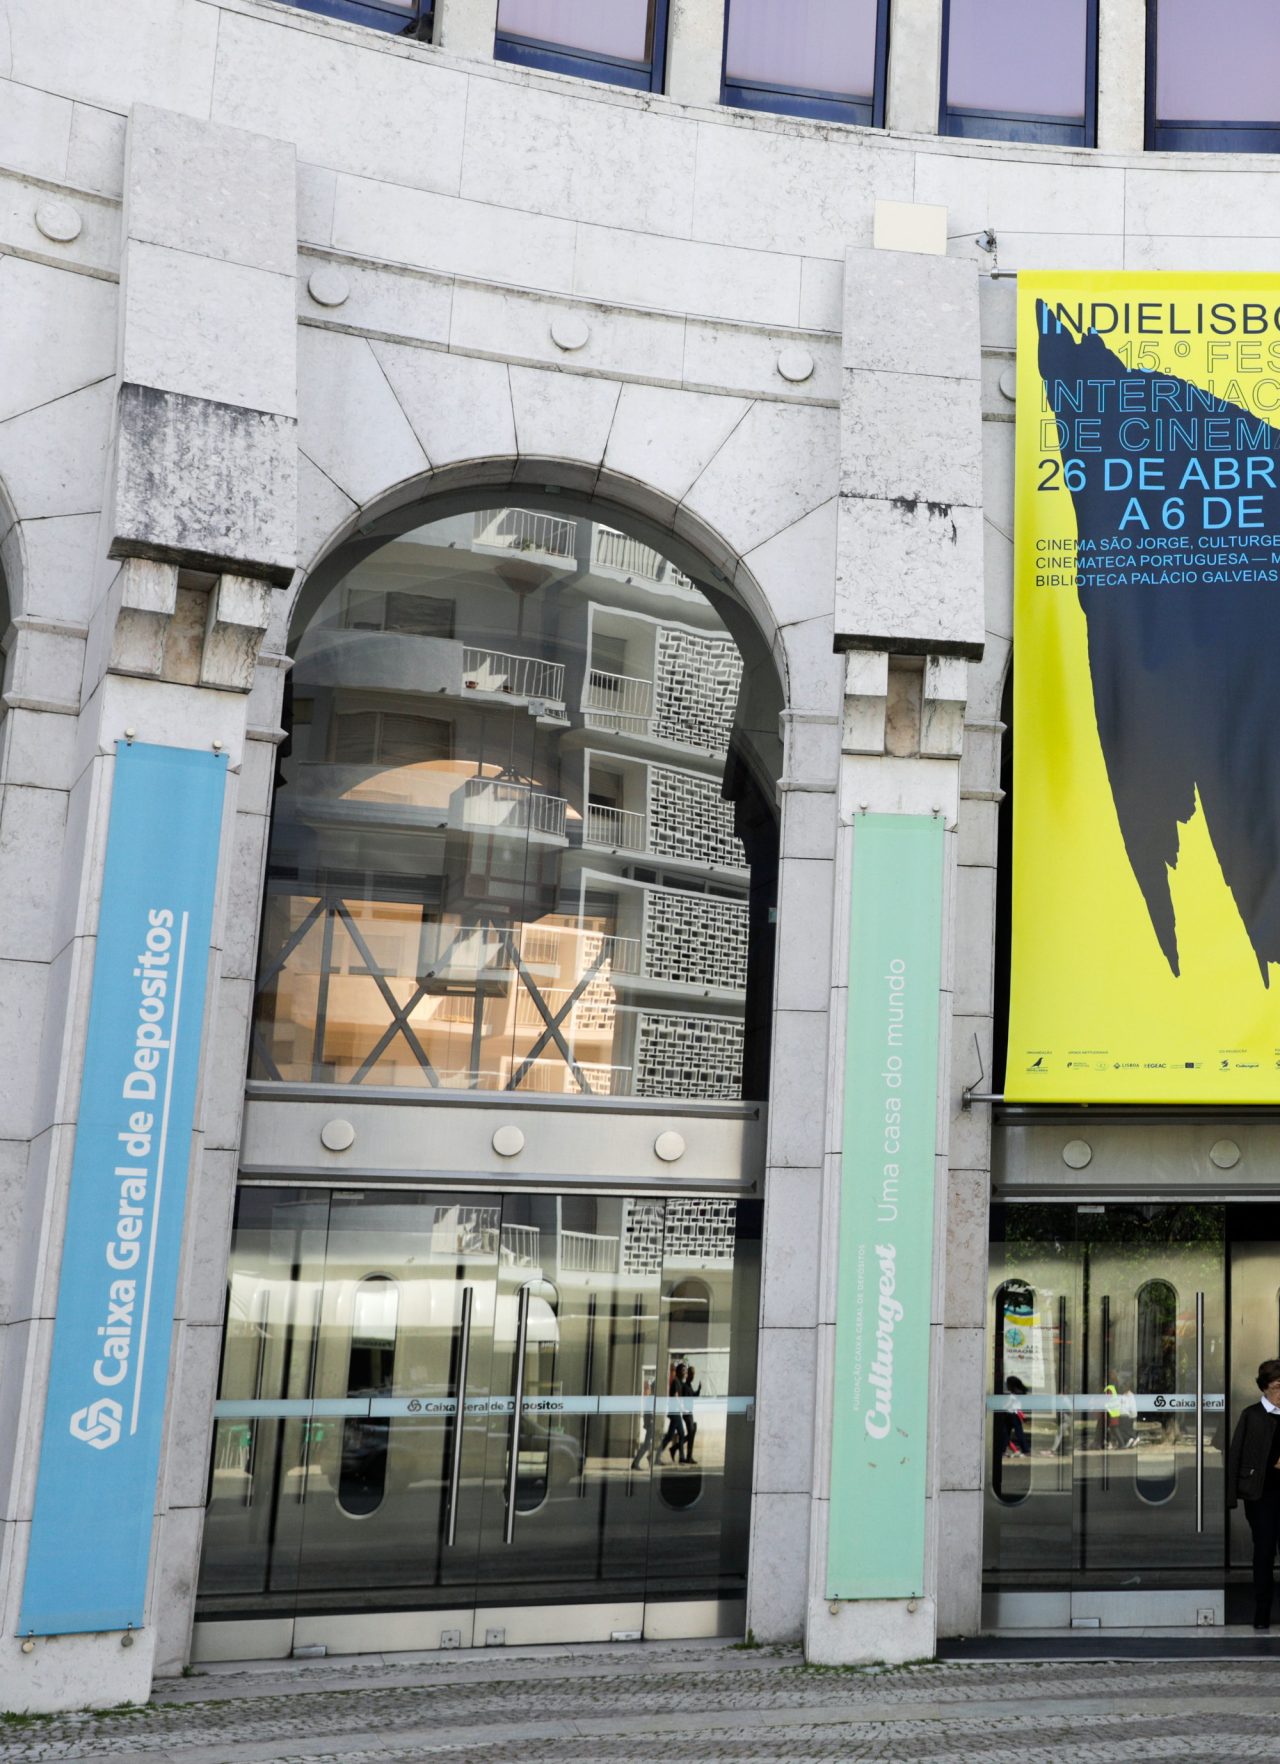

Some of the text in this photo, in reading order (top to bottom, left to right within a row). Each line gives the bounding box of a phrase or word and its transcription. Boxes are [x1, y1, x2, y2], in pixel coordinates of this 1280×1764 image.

[1039, 417, 1102, 452] DE
[1037, 458, 1087, 492] 26
[1104, 457, 1166, 491] DE
[1118, 497, 1150, 531] A
[1161, 496, 1186, 531] 6
[1203, 495, 1265, 530] DE
[1036, 539, 1097, 551] CINEMA
[1100, 536, 1132, 550] SÃO
[1136, 537, 1194, 550] JORGE,
[1036, 555, 1136, 569] CINEMATECA
[1140, 553, 1249, 567] PORTUGUESA
[1036, 569, 1278, 587] BIBLIOTECA PALÁCIO GALVEIAS
[877, 958, 905, 1222] Uma casa do mundo
[118, 1111, 153, 1157] de
[106, 1167, 148, 1271] Geral
[857, 1293, 863, 1304] DE
[93, 1279, 136, 1387] Caixa
[865, 1242, 904, 1440] Culturgest
[425, 1401, 456, 1412] Caixa
[490, 1400, 505, 1411] de
[1169, 1399, 1196, 1408] Caixa
